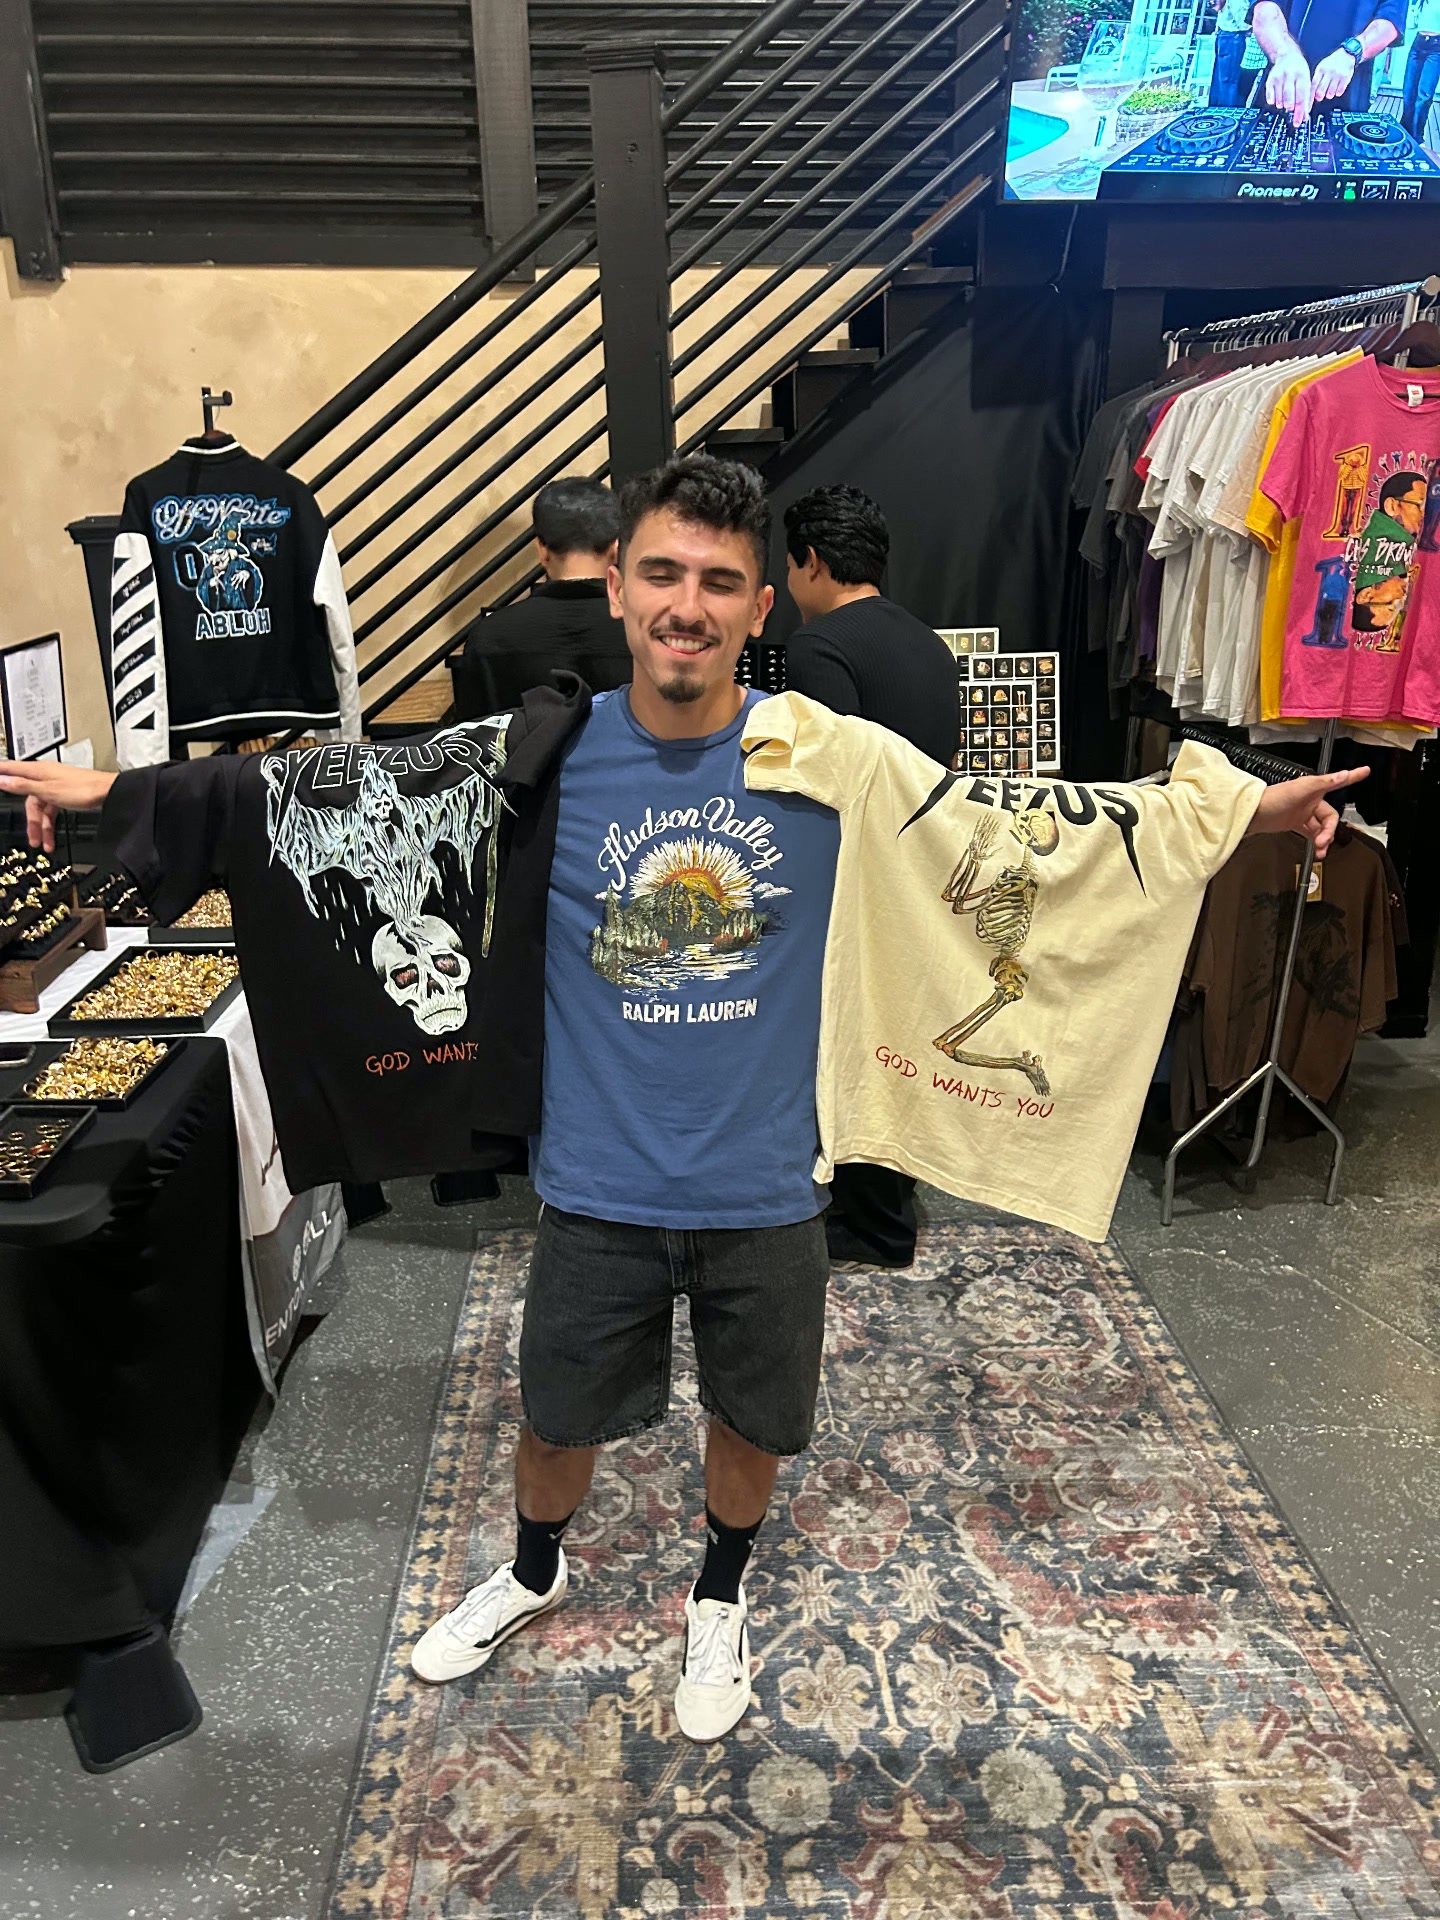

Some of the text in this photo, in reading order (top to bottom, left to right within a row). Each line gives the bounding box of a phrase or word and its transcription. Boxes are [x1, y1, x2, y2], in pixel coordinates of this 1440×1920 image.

[196, 608, 271, 641] ABLOH
[597, 796, 784, 892] Hudson Valley
[622, 998, 758, 1024] RALPH LAUREN
[365, 1051, 411, 1077] GOD
[874, 1045, 1055, 1119] GOD WANTS YOU
